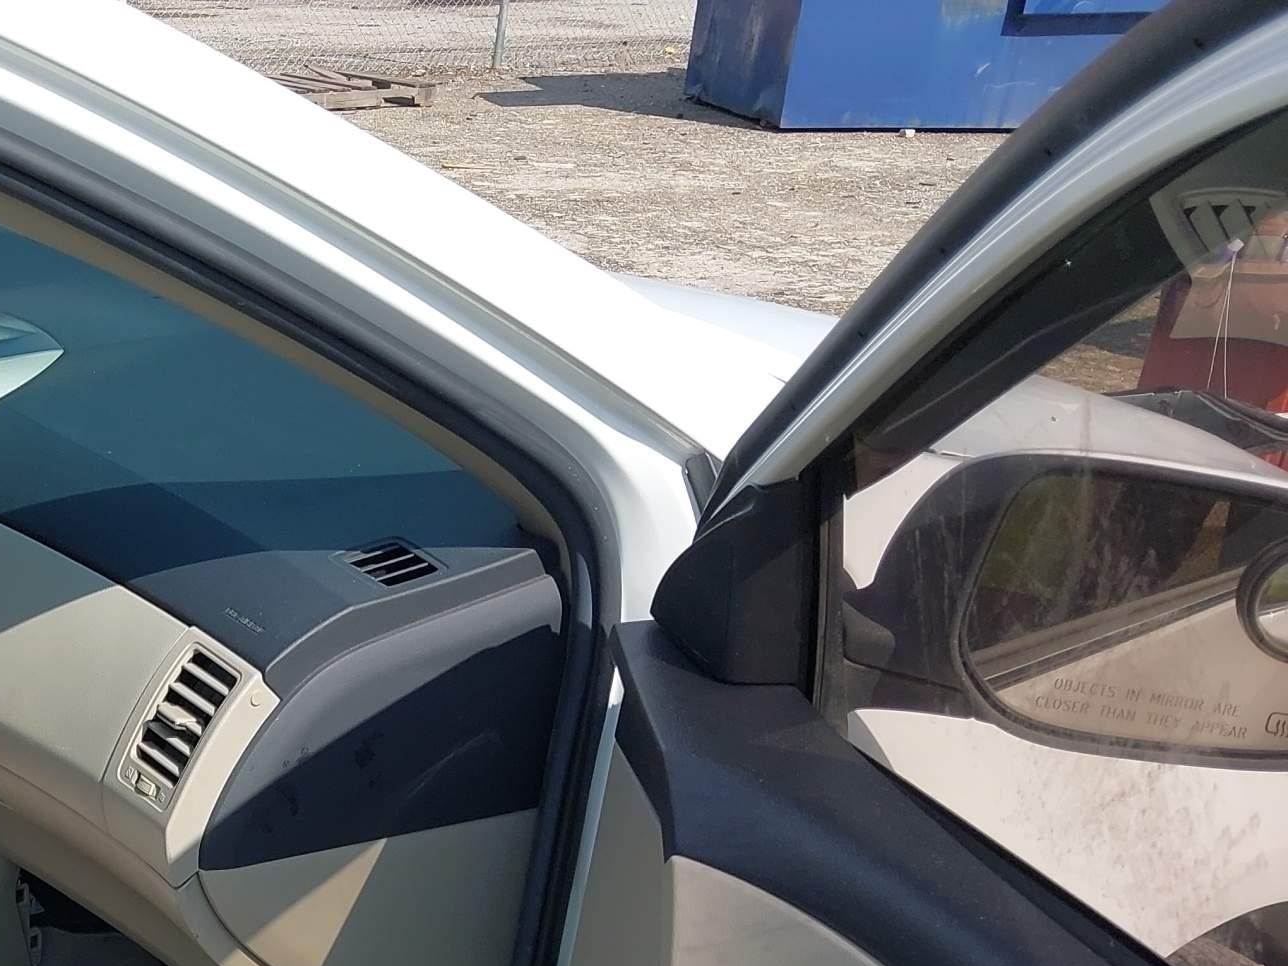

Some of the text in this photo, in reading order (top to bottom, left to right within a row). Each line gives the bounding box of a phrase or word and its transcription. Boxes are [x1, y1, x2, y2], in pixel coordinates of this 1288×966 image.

[1035, 696, 1248, 738] CLOSER THAN THEY APPEAR
[1054, 678, 1240, 717] OBJECTS IN MIRROR ARE
